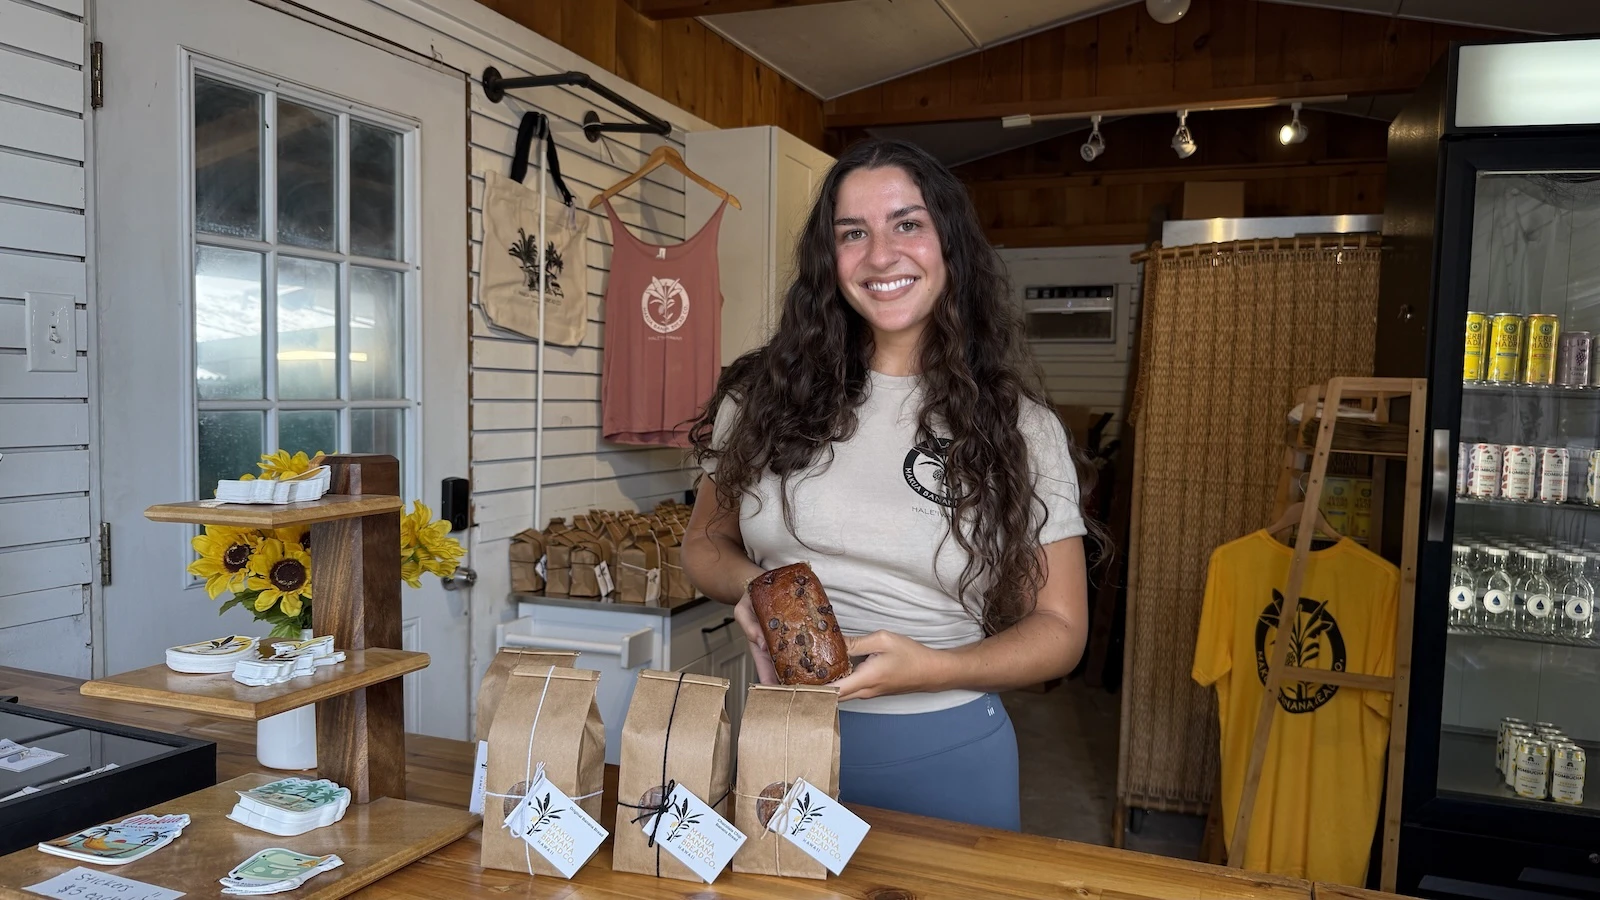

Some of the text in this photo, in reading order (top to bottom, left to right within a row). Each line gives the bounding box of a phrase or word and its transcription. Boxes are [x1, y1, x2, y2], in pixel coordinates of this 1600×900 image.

[905, 468, 922, 492] MAKUA
[550, 822, 575, 845] MAKUA
[570, 806, 604, 838] Original Banana Bread
[814, 820, 839, 840] MAKUA
[537, 840, 554, 855] HAWAII
[541, 834, 574, 866] BREAD CO.
[545, 829, 574, 855] BANANA
[685, 834, 714, 858] BANANA
[690, 827, 715, 850] MAKUA
[803, 839, 821, 853] HAWAII
[806, 832, 842, 862] BREAD CO.
[810, 826, 840, 850] BANANA
[678, 845, 695, 860] HAWAII
[681, 839, 716, 869] BREAD CO.
